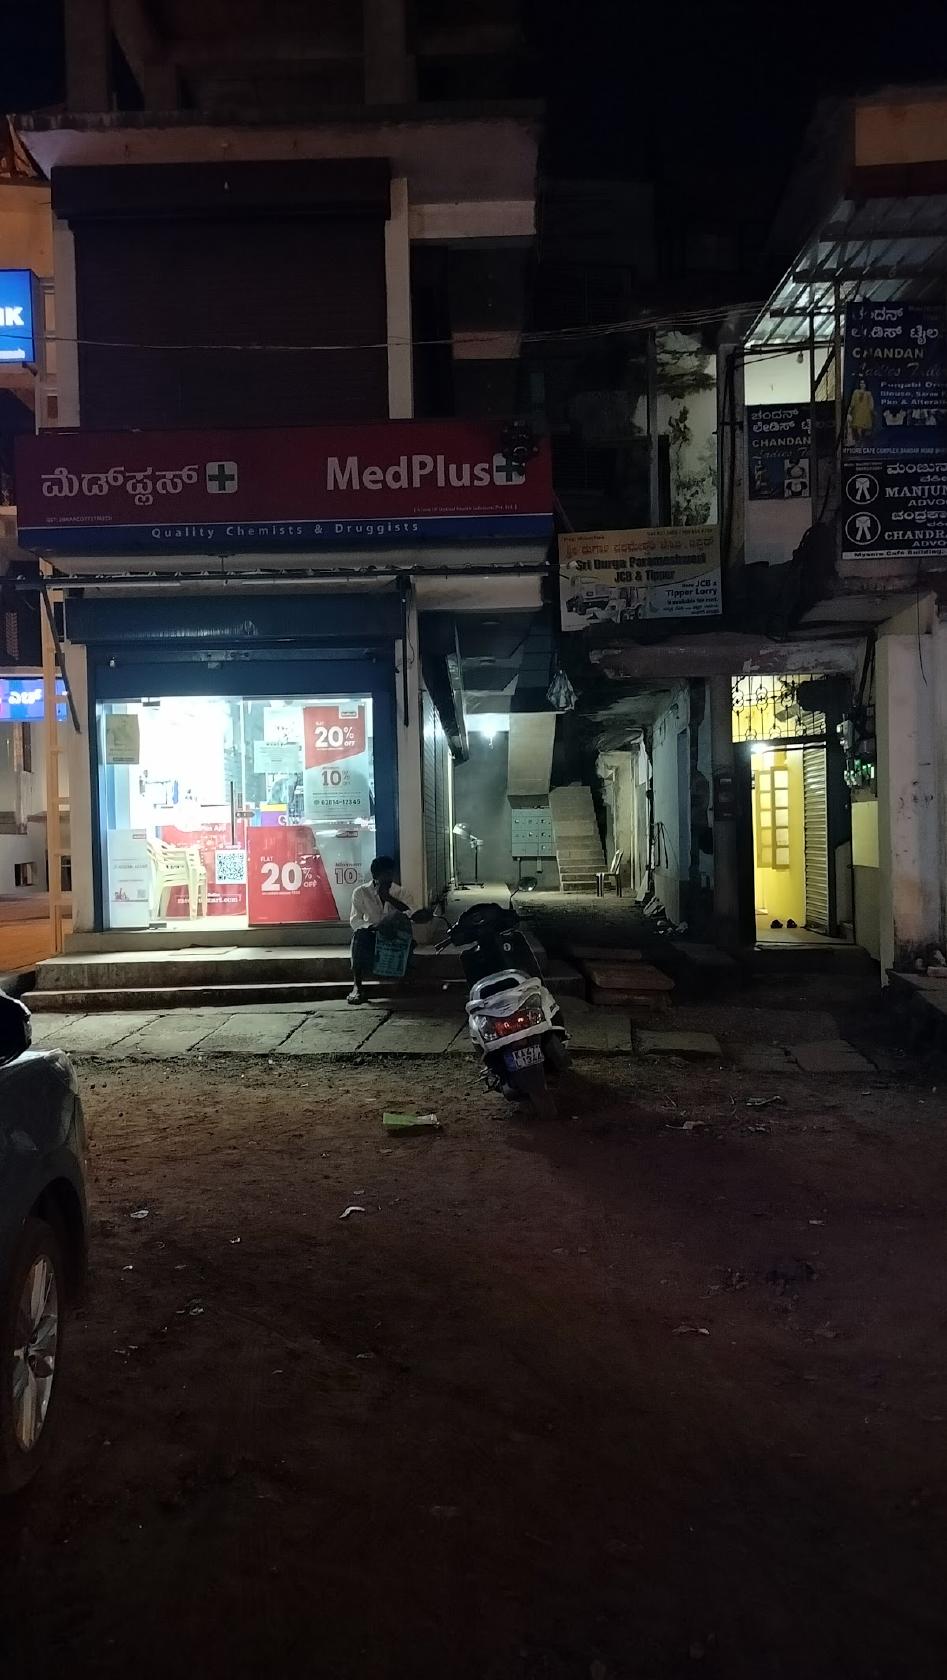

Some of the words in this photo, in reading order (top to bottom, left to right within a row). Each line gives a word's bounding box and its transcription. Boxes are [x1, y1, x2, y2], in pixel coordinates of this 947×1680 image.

[0, 306, 25, 326] K
[751, 435, 812, 448] CHANDAN
[326, 454, 491, 491] MedPlus
[151, 526, 215, 539] Quality
[226, 524, 304, 537] Chemists
[313, 523, 323, 535] &
[335, 520, 419, 535] Druggists
[884, 529, 947, 541] CHANDR
[911, 539, 947, 548] ADVO
[614, 571, 633, 583] JCB
[634, 571, 643, 582] &
[695, 579, 711, 588] JCB
[667, 589, 693, 599] Tipper
[695, 588, 718, 597] Lorry
